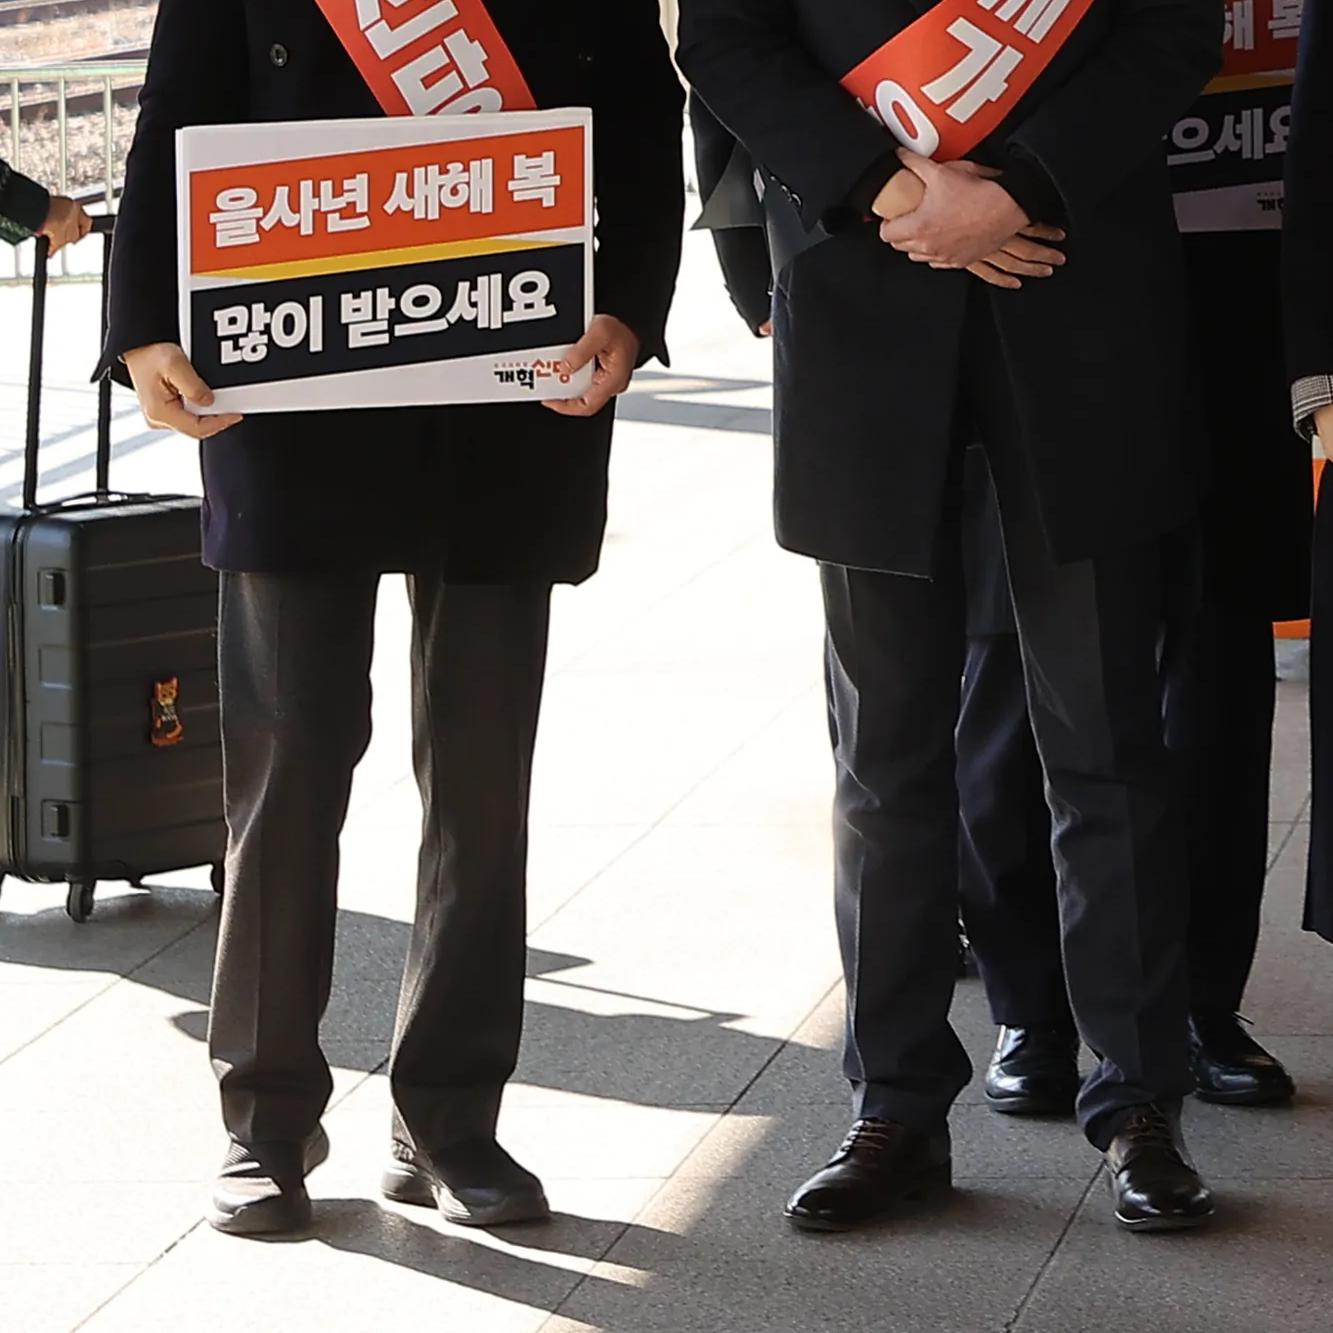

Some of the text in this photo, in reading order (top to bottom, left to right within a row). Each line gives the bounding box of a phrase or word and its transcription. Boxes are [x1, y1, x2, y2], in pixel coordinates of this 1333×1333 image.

[209, 150, 561, 248] 을사년 새해 복
[212, 270, 557, 365] 많이 받으세요
